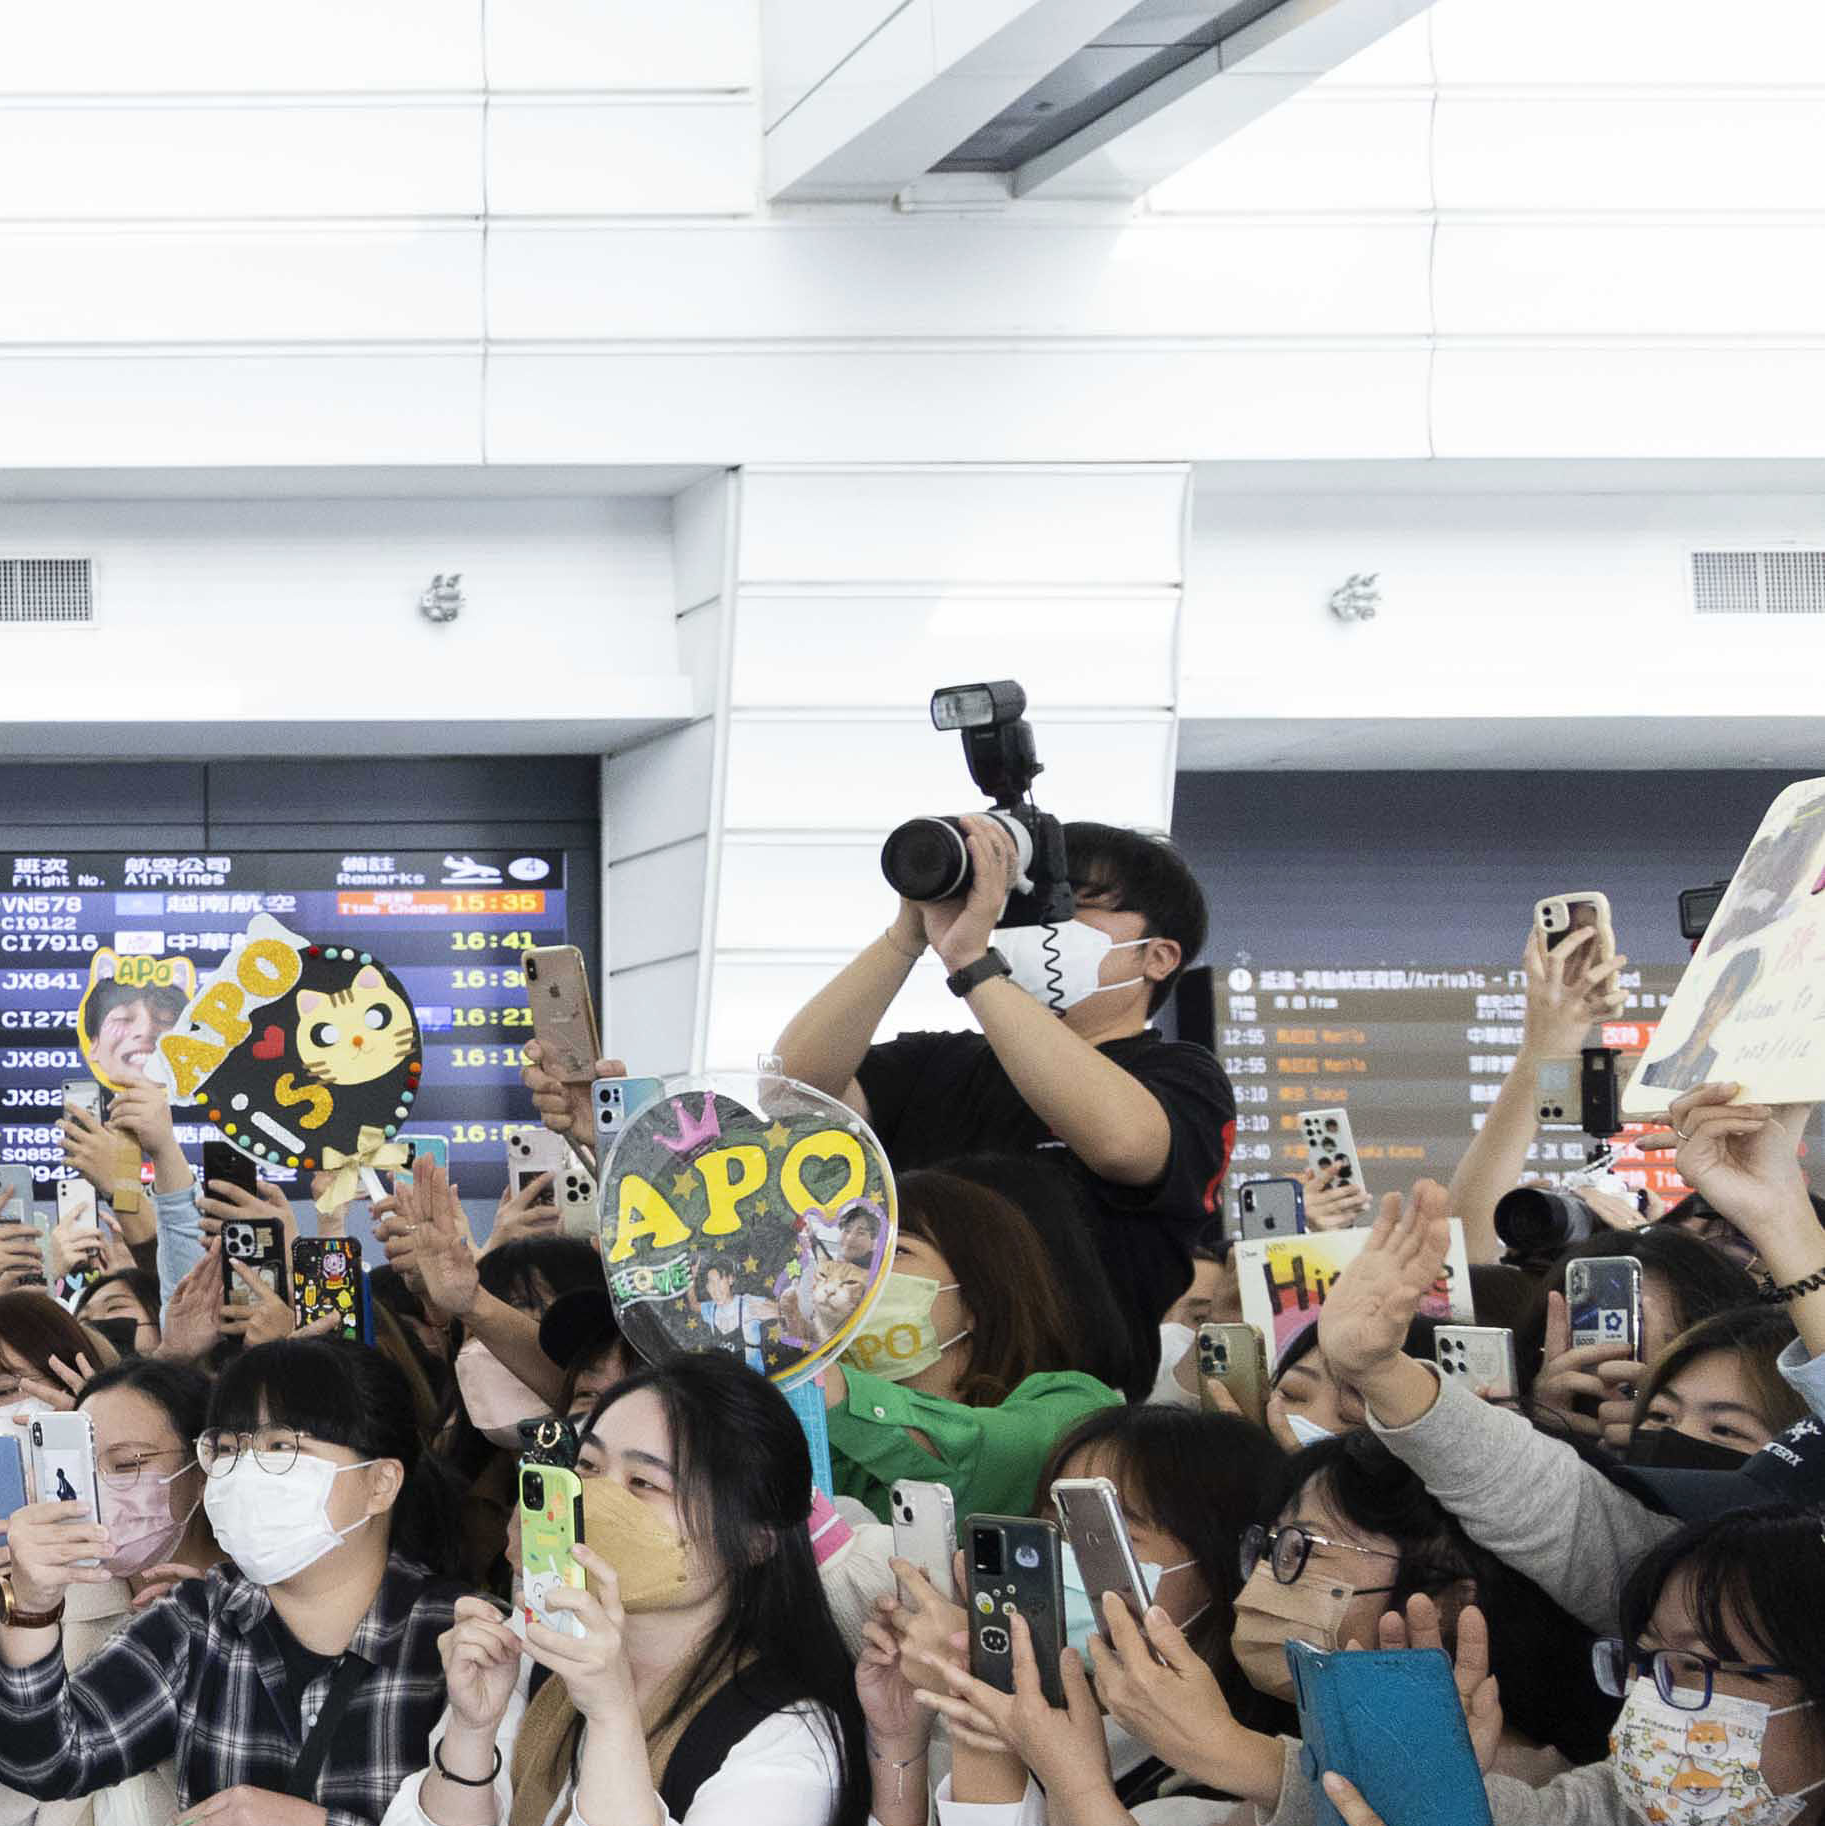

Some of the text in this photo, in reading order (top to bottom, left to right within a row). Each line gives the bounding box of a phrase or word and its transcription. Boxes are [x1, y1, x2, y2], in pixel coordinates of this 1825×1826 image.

[13, 875, 69, 887] Flight
[125, 873, 224, 885] Airlines
[337, 873, 424, 885] Remarks
[2, 896, 82, 912] VN578
[166, 896, 296, 912] 越南航空
[1, 917, 76, 930] CI9122
[1, 935, 98, 951] CI7916
[119, 962, 171, 983] APO
[2, 973, 82, 989] JX841
[160, 939, 303, 1097] APO
[2, 1051, 82, 1068] JX801
[1235, 1087, 1269, 1102] 5:10
[607, 1129, 866, 1264] APO
